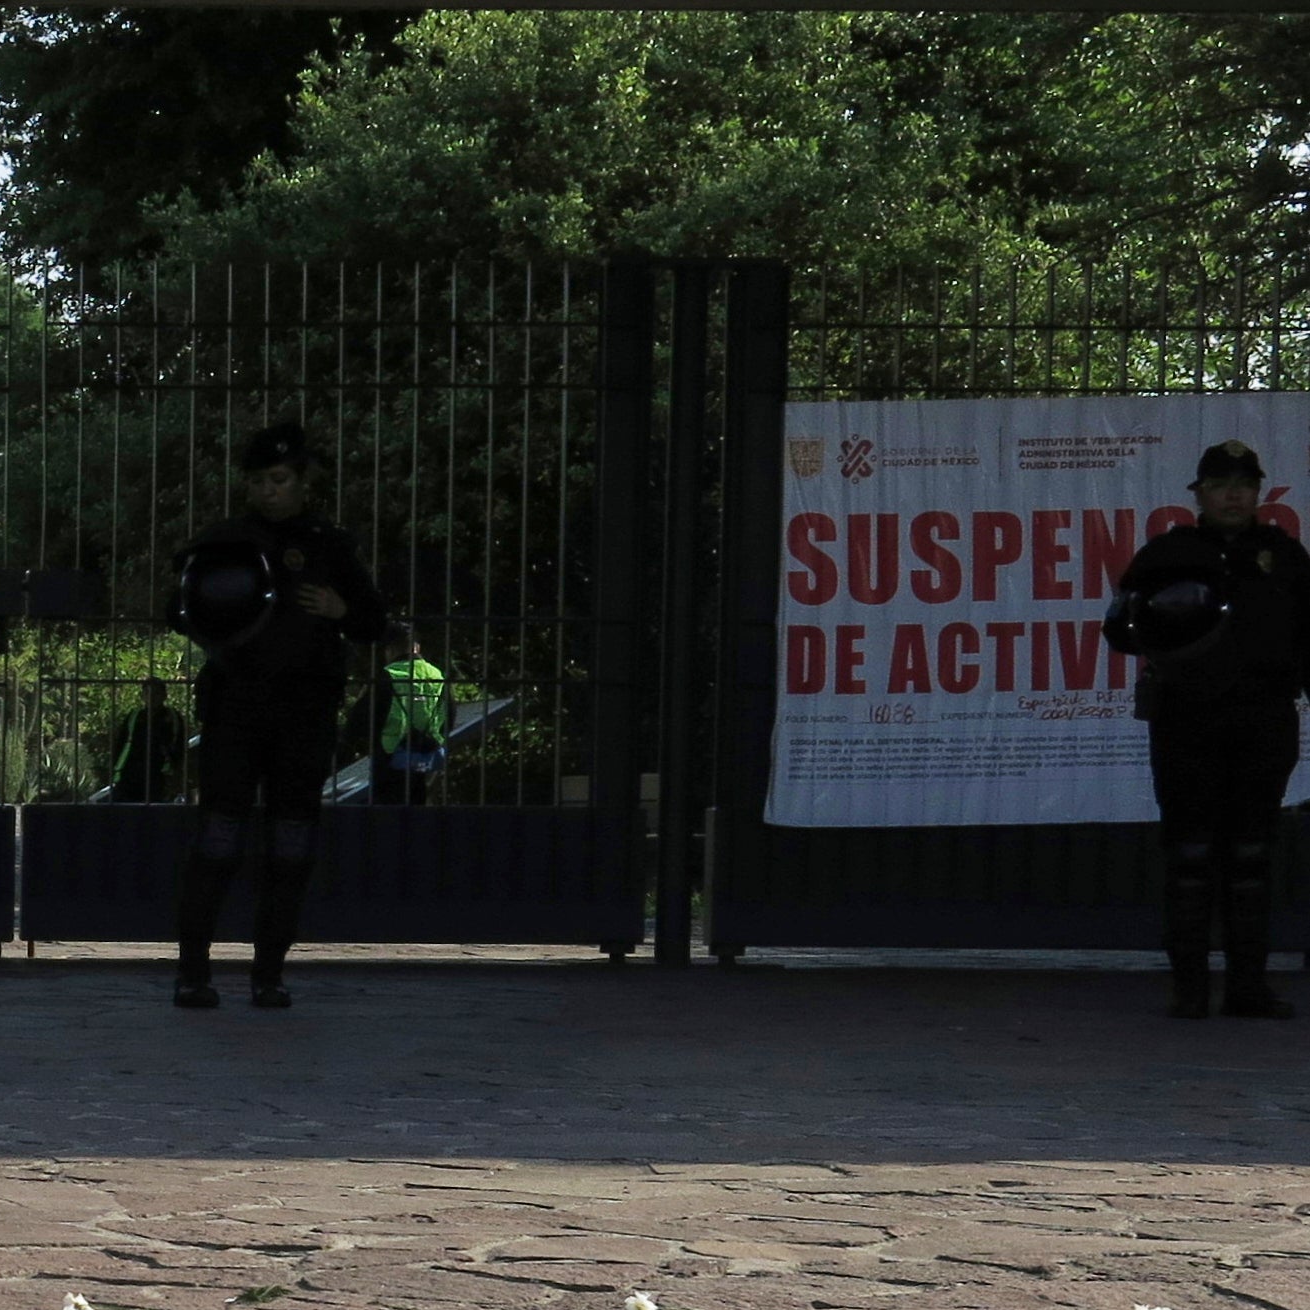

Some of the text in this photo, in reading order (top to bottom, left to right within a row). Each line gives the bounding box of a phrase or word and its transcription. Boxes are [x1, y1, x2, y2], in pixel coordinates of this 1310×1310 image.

[1018, 433, 1164, 447] INSTITUTO DE VERIFICACIÓN
[1018, 447, 1137, 459] ADMINISTRATIVA DE LA
[881, 457, 923, 468] CIUDAD
[924, 457, 938, 467] DE
[1018, 460, 1058, 470] CIUDAD
[1060, 460, 1075, 470] DE
[786, 623, 867, 695] DE
